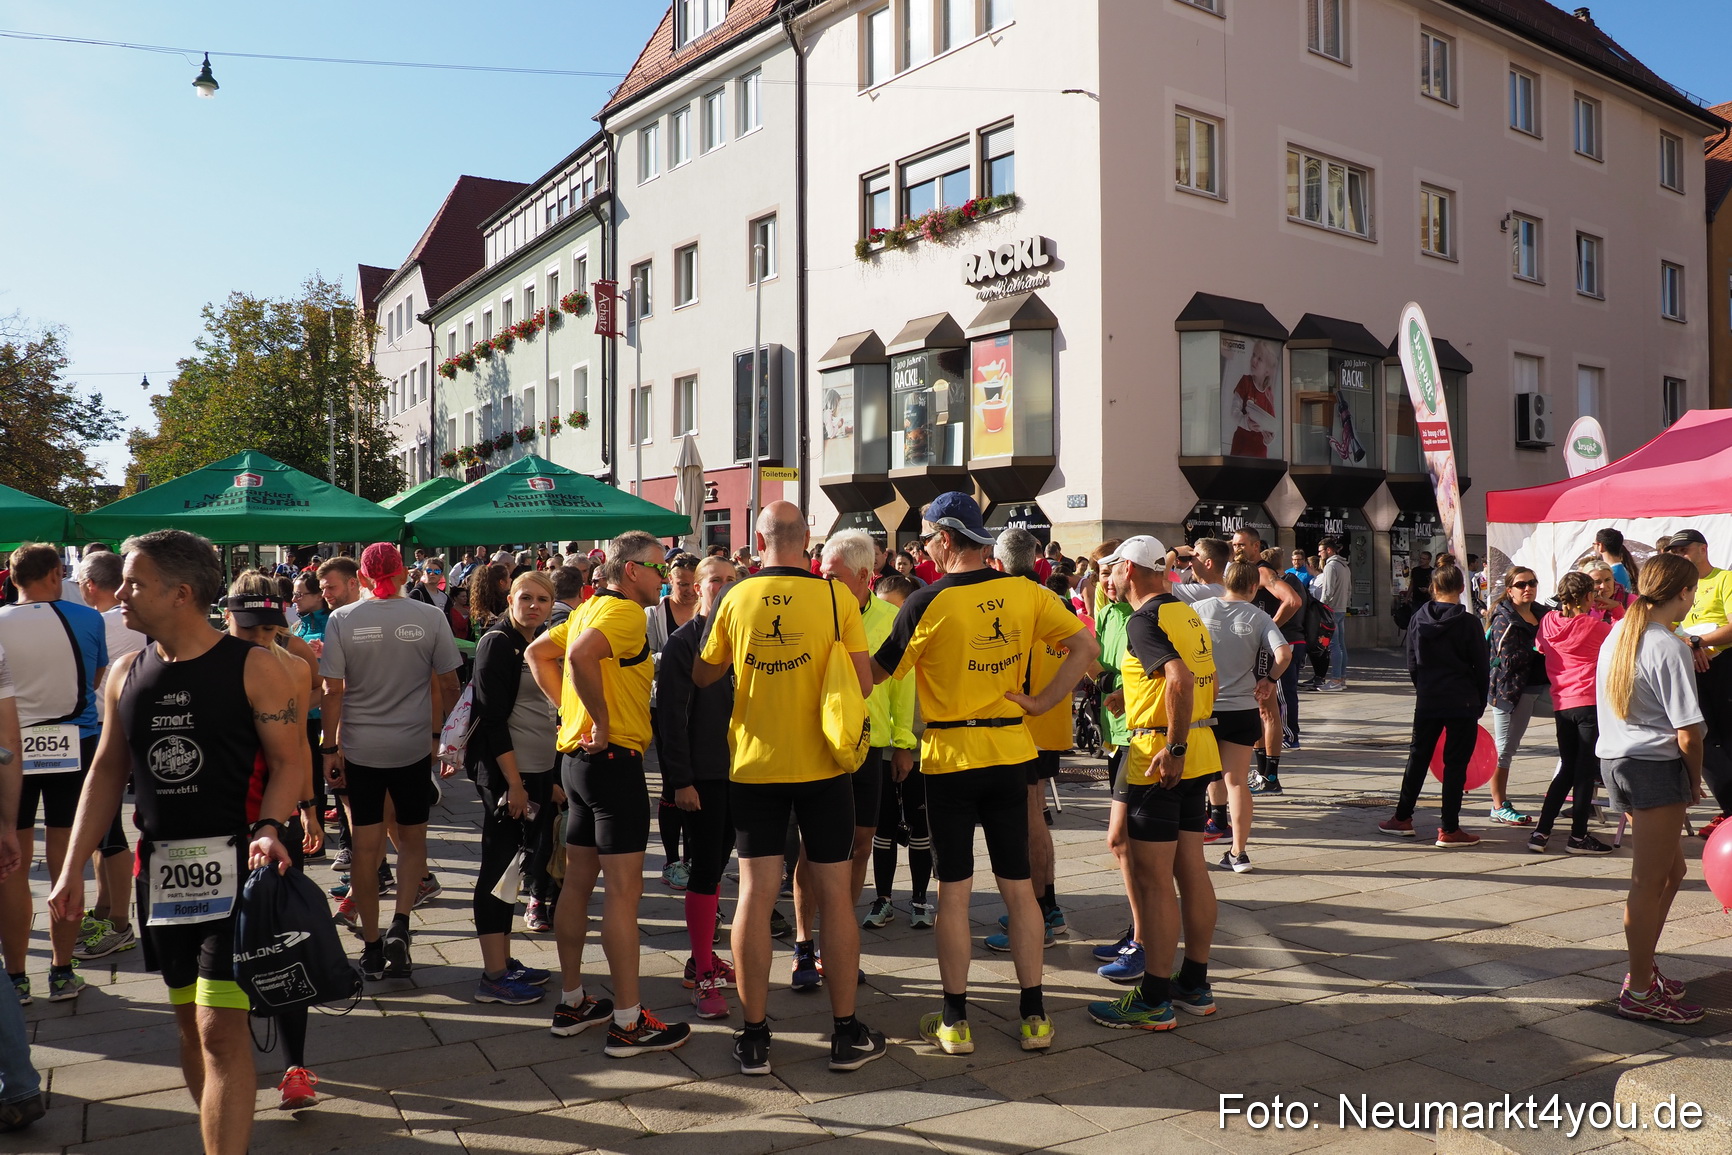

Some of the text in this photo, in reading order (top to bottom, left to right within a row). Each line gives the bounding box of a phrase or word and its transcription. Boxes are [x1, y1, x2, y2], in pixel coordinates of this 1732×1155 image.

[961, 235, 1049, 285] RACKL
[599, 292, 612, 331] Achatz
[1341, 368, 1364, 388] RACKL
[761, 469, 792, 479] Toiletten
[184, 496, 310, 509] Lammsbräu
[203, 490, 294, 500] Neumarkter
[507, 493, 584, 501] Neumarkter
[493, 499, 604, 509] Lammsbräu
[1324, 518, 1343, 534] RACKL
[1415, 522, 1432, 537] RACKL
[762, 594, 793, 607] TSV
[976, 598, 1005, 614] TSV
[398, 628, 422, 638] Hervis
[745, 652, 812, 675] Burgthann
[151, 712, 194, 727] smart
[23, 735, 70, 753] 2654
[152, 739, 186, 771] Maisel's
[166, 749, 198, 772] Weisse
[156, 784, 199, 795] www.ebf.li
[169, 846, 208, 858] BOCK
[160, 861, 223, 890] 2098
[174, 902, 210, 915] Ronald
